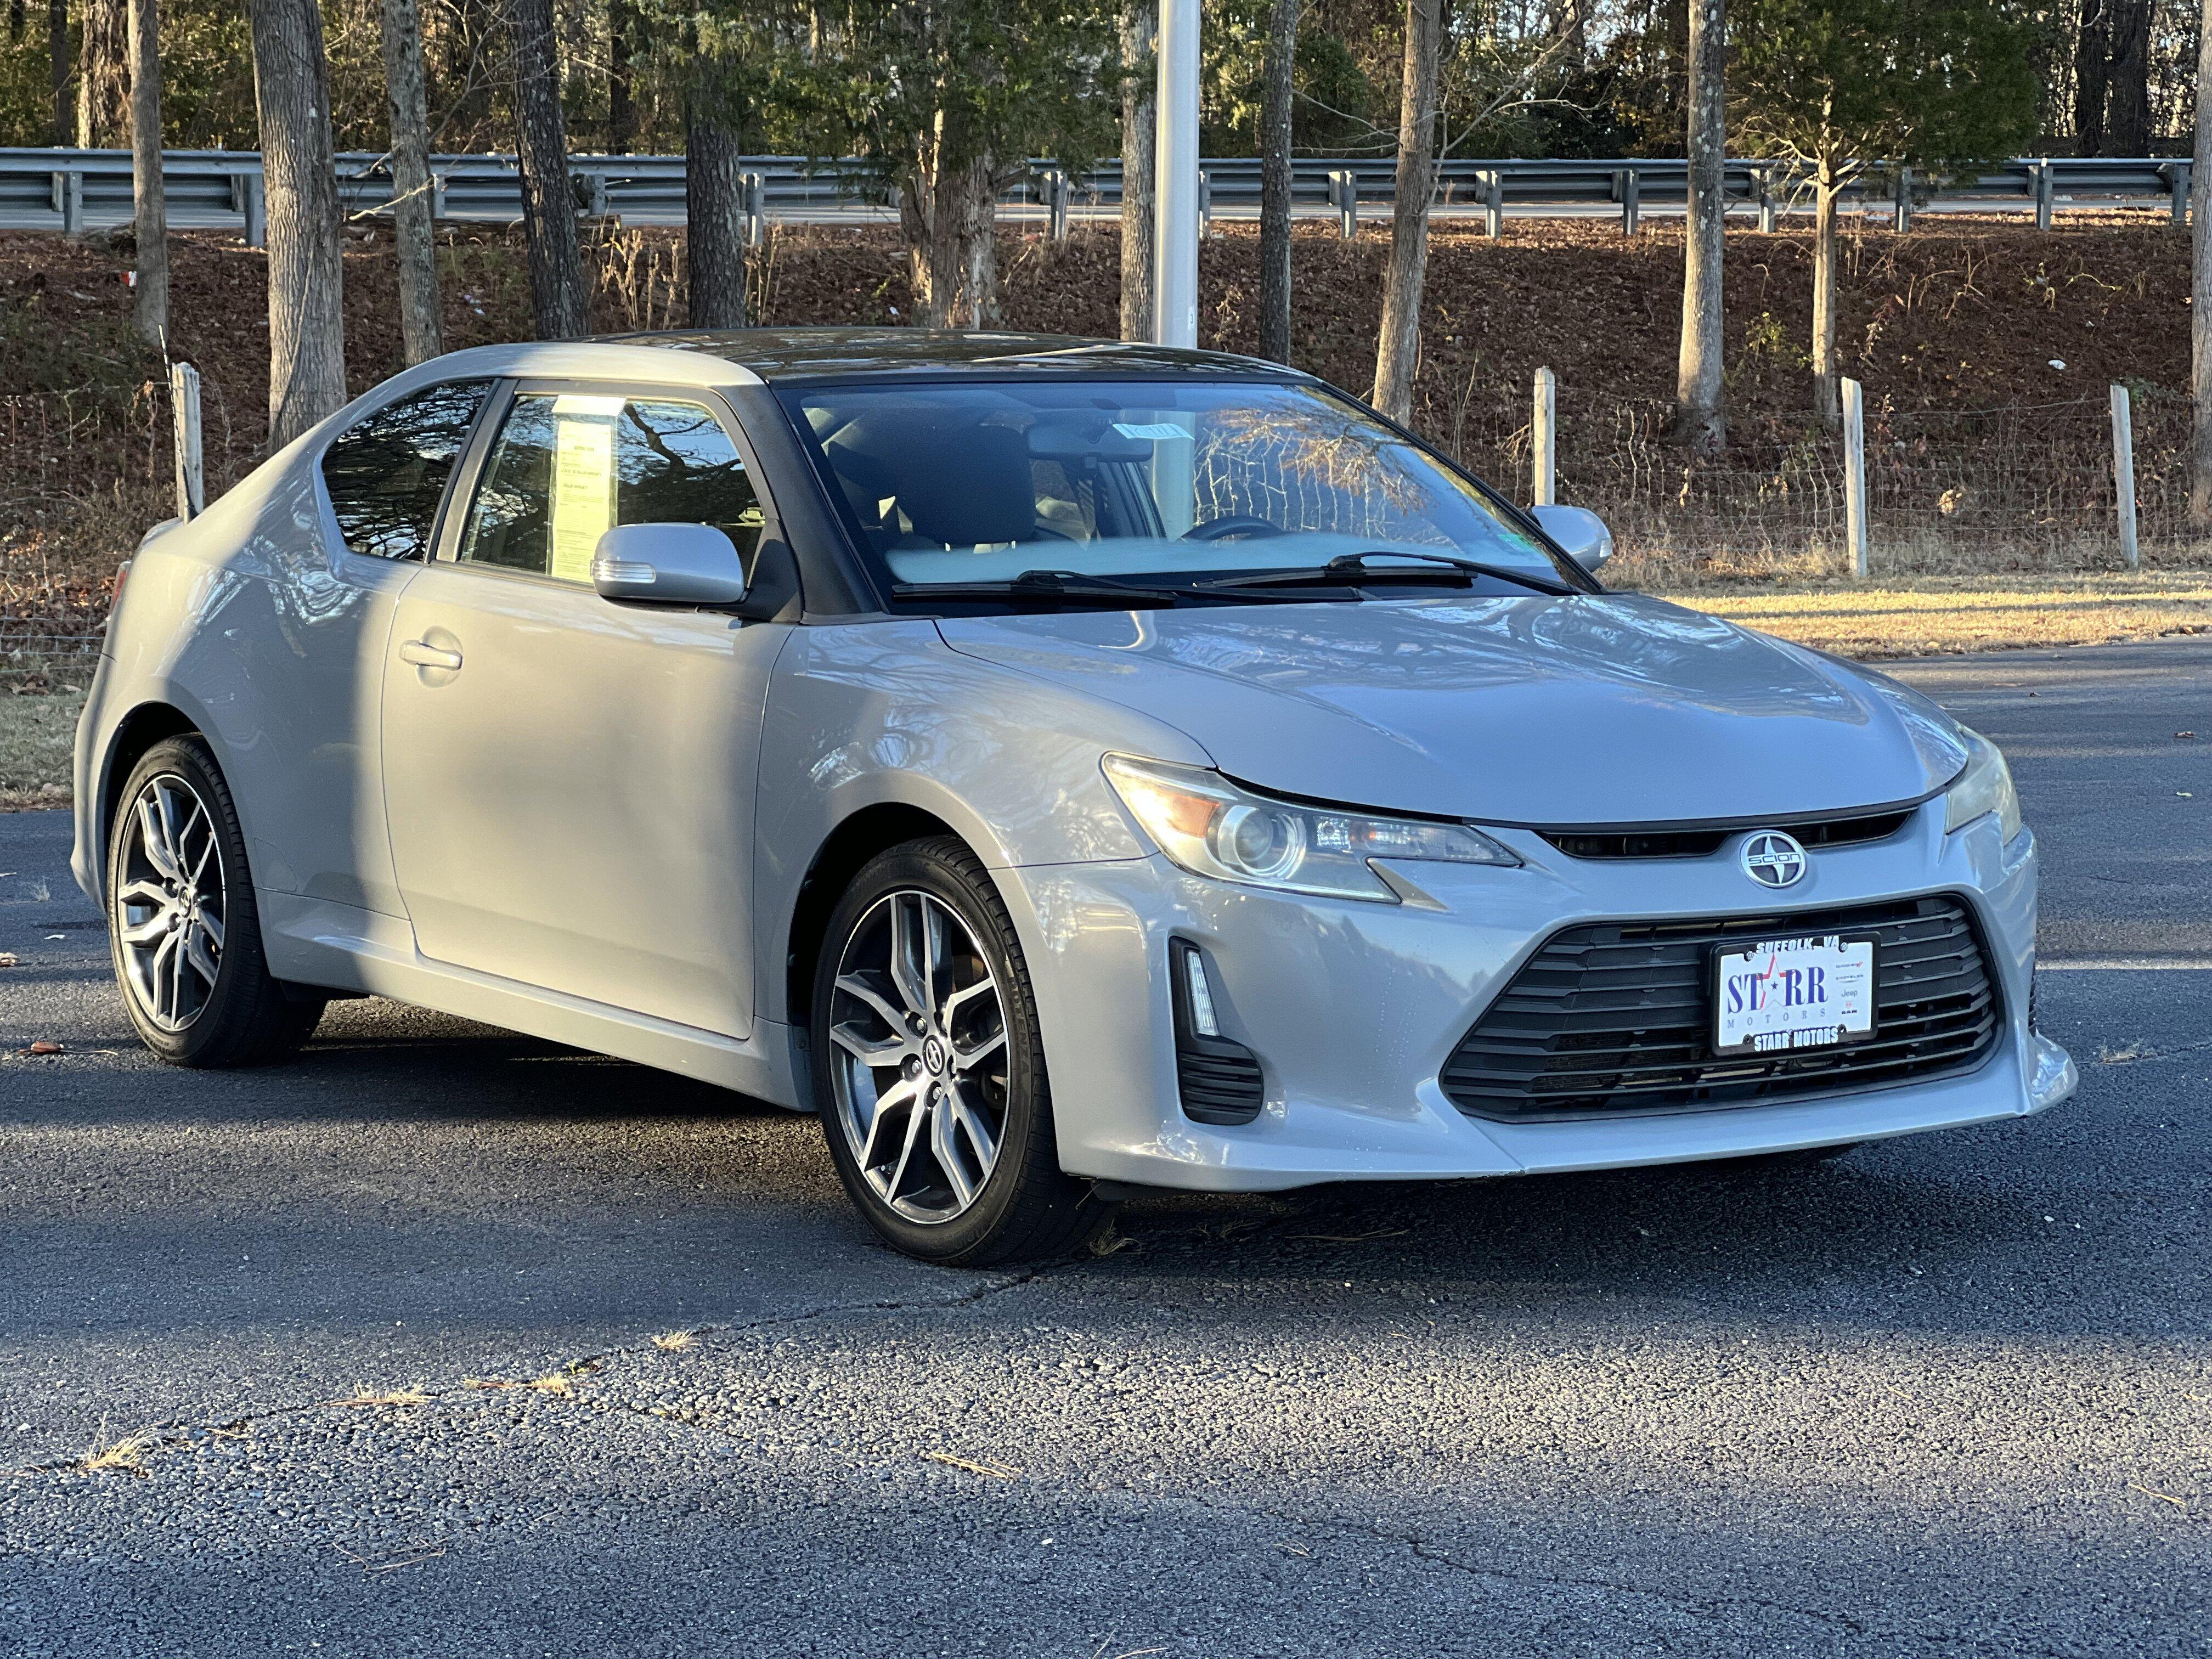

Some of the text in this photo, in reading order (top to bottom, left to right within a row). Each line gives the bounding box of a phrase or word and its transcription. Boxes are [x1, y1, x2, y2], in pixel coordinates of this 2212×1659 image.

[1190, 313, 1194, 324] 3
[1824, 935, 1839, 948] VA
[1727, 1008, 1826, 1028] MOTORS
[1754, 1027, 1838, 1052] STARR MOTORS
